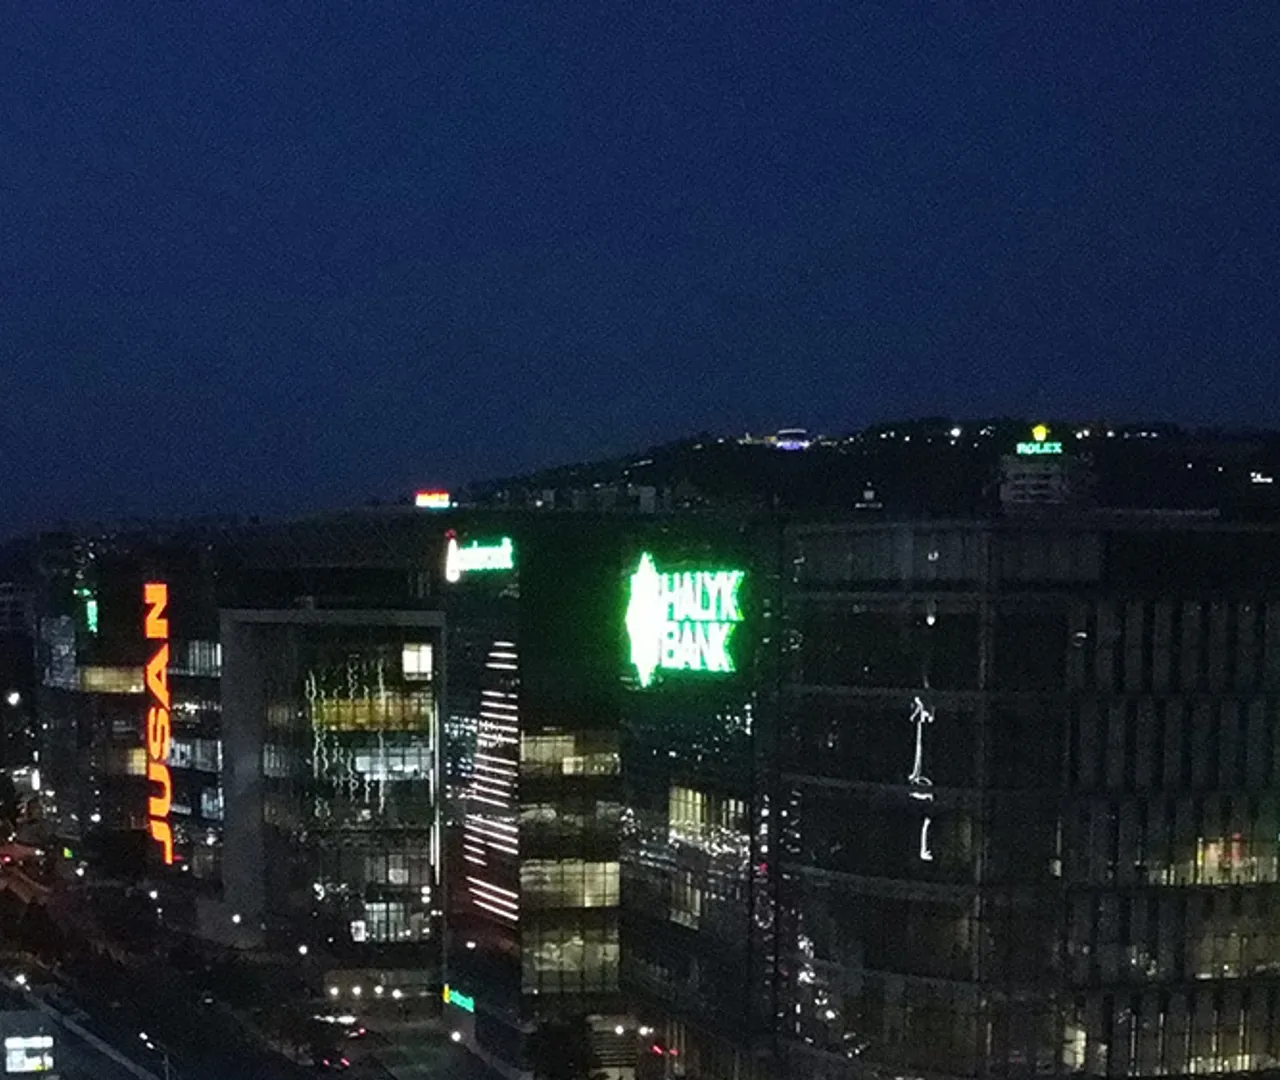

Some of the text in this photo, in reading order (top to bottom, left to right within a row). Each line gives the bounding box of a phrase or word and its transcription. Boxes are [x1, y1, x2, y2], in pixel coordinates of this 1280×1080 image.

[1016, 442, 1062, 455] ROLEX
[661, 571, 745, 620] HALYK
[661, 620, 736, 672] BANK
[145, 583, 173, 865] JUSAN
